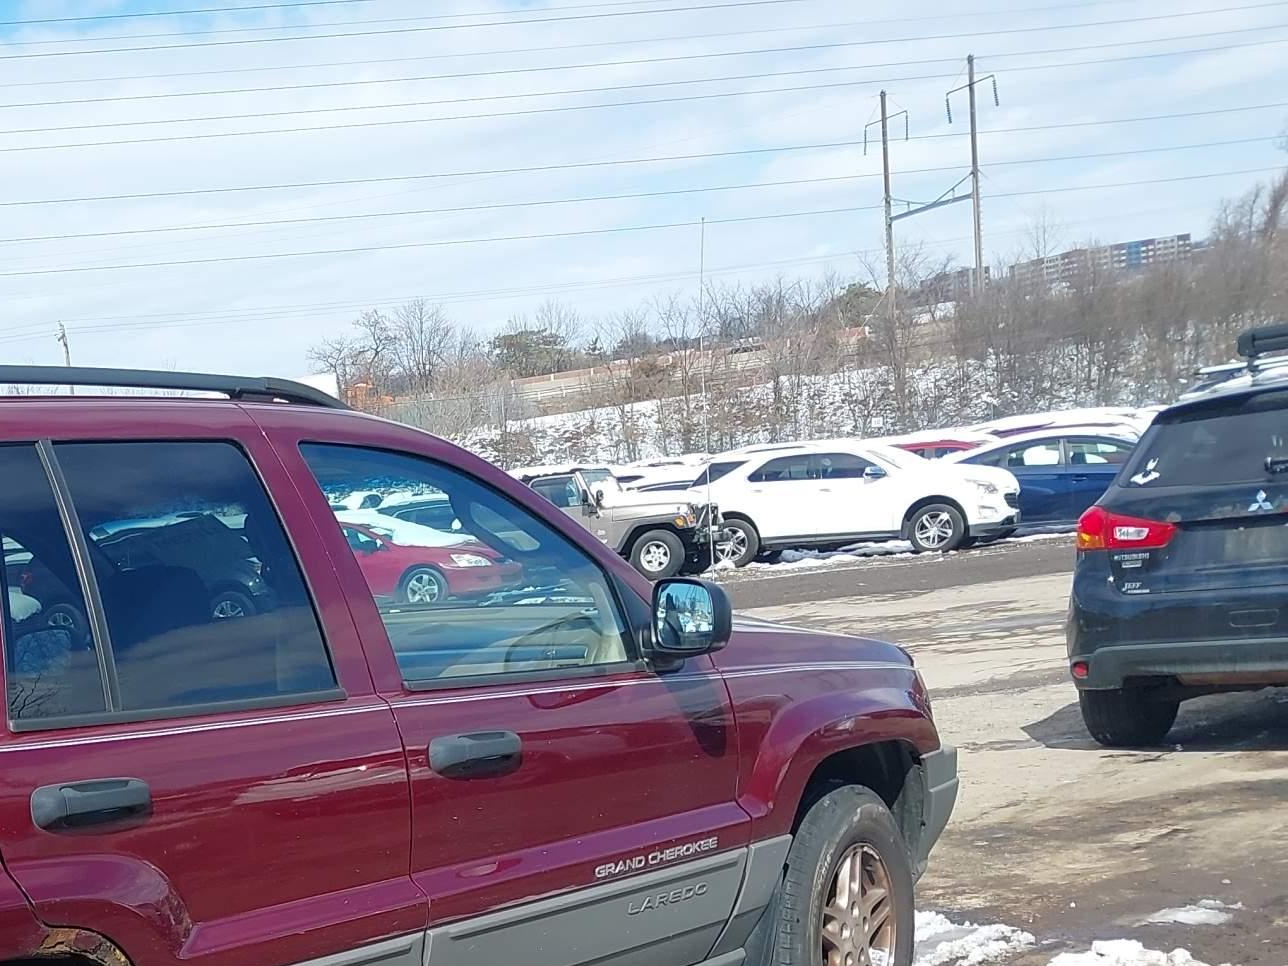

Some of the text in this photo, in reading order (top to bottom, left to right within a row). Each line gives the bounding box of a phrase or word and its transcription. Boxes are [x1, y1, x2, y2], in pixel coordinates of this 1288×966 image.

[595, 837, 718, 877] GRAND CHEROKEE
[628, 882, 708, 914] LAREDO
